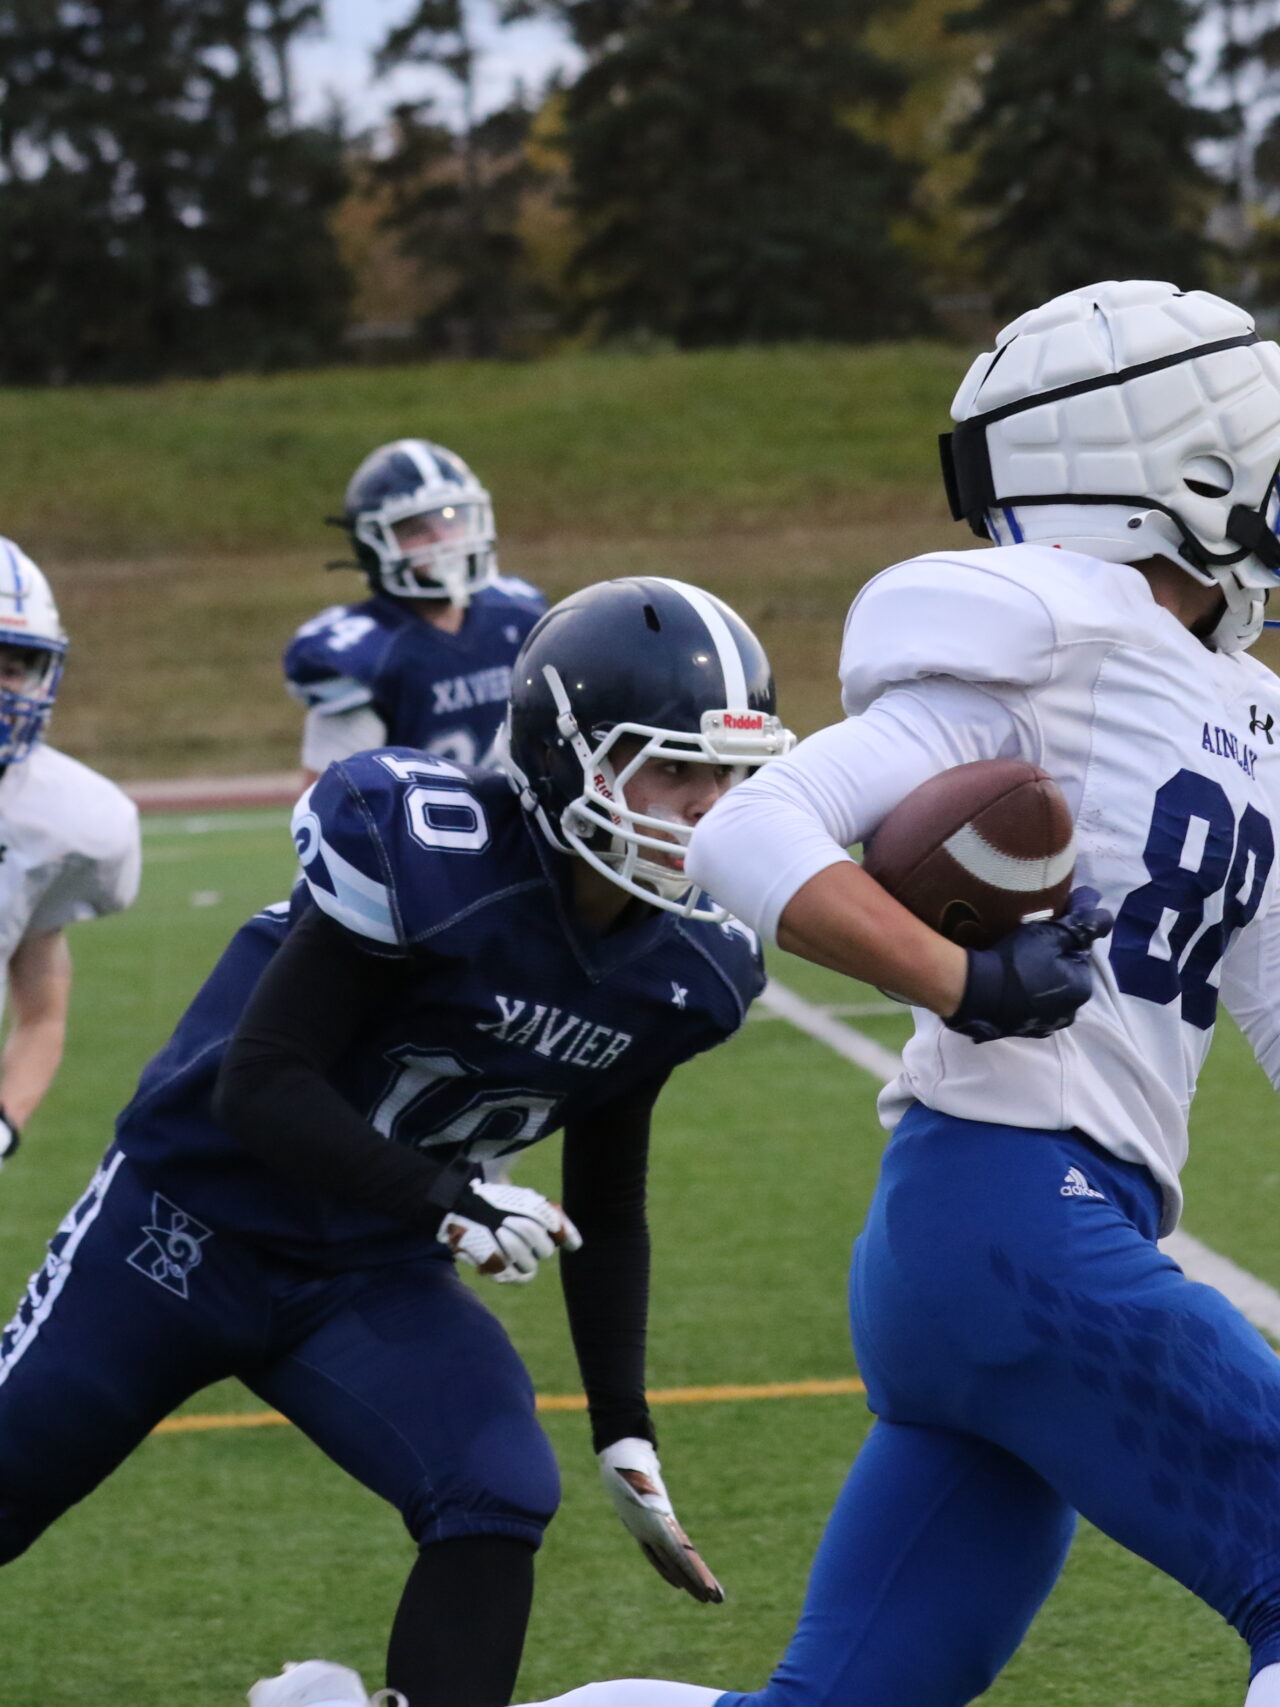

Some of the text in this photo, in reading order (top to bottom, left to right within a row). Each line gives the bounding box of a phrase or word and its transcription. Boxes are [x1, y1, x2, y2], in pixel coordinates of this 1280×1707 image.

[723, 714, 763, 730] Riddell
[1202, 721, 1257, 781] AINLAY
[374, 754, 492, 854] 10
[474, 995, 633, 1070] XAVIER
